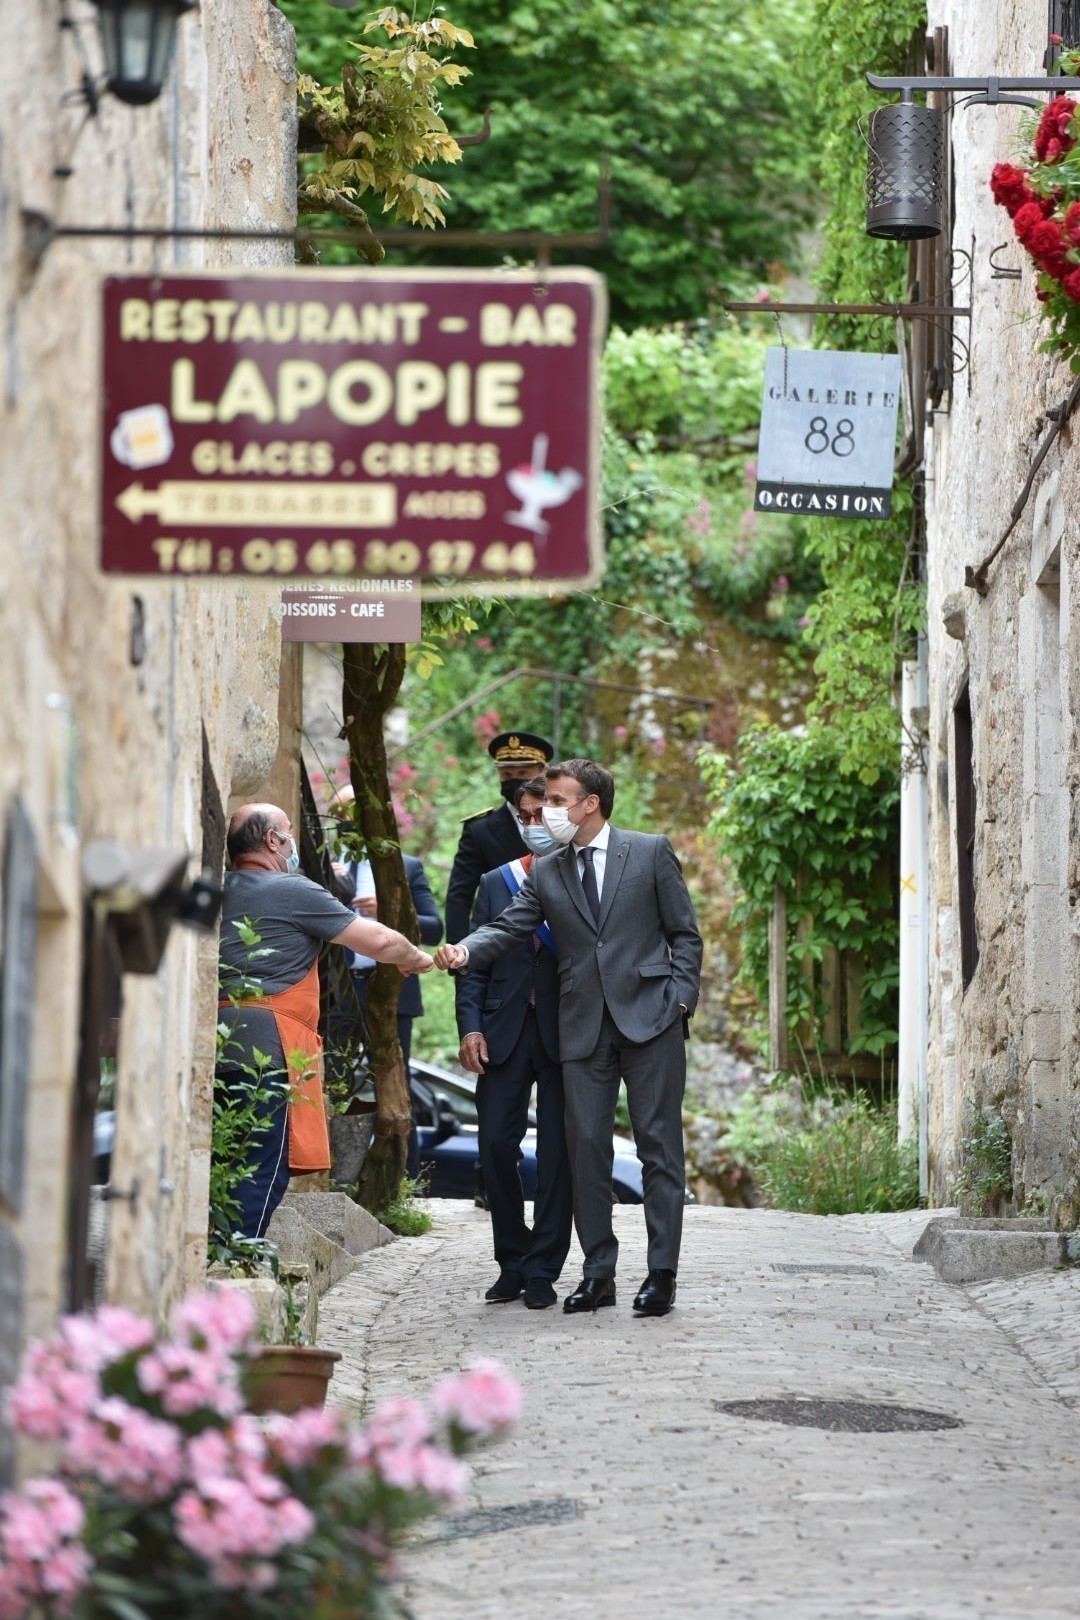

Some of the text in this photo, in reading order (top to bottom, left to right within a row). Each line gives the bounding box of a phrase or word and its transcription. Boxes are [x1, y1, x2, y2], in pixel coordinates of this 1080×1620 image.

[121, 298, 429, 344] RESTAURANT
[479, 303, 577, 346] BAR
[171, 358, 524, 427] LAPOPIE
[769, 386, 895, 408] GALERIE
[805, 416, 855, 457] 88
[191, 439, 333, 475] GLACES
[759, 490, 883, 512] OCCASION
[241, 538, 299, 573] 05
[350, 601, 384, 617] CAFÉ
